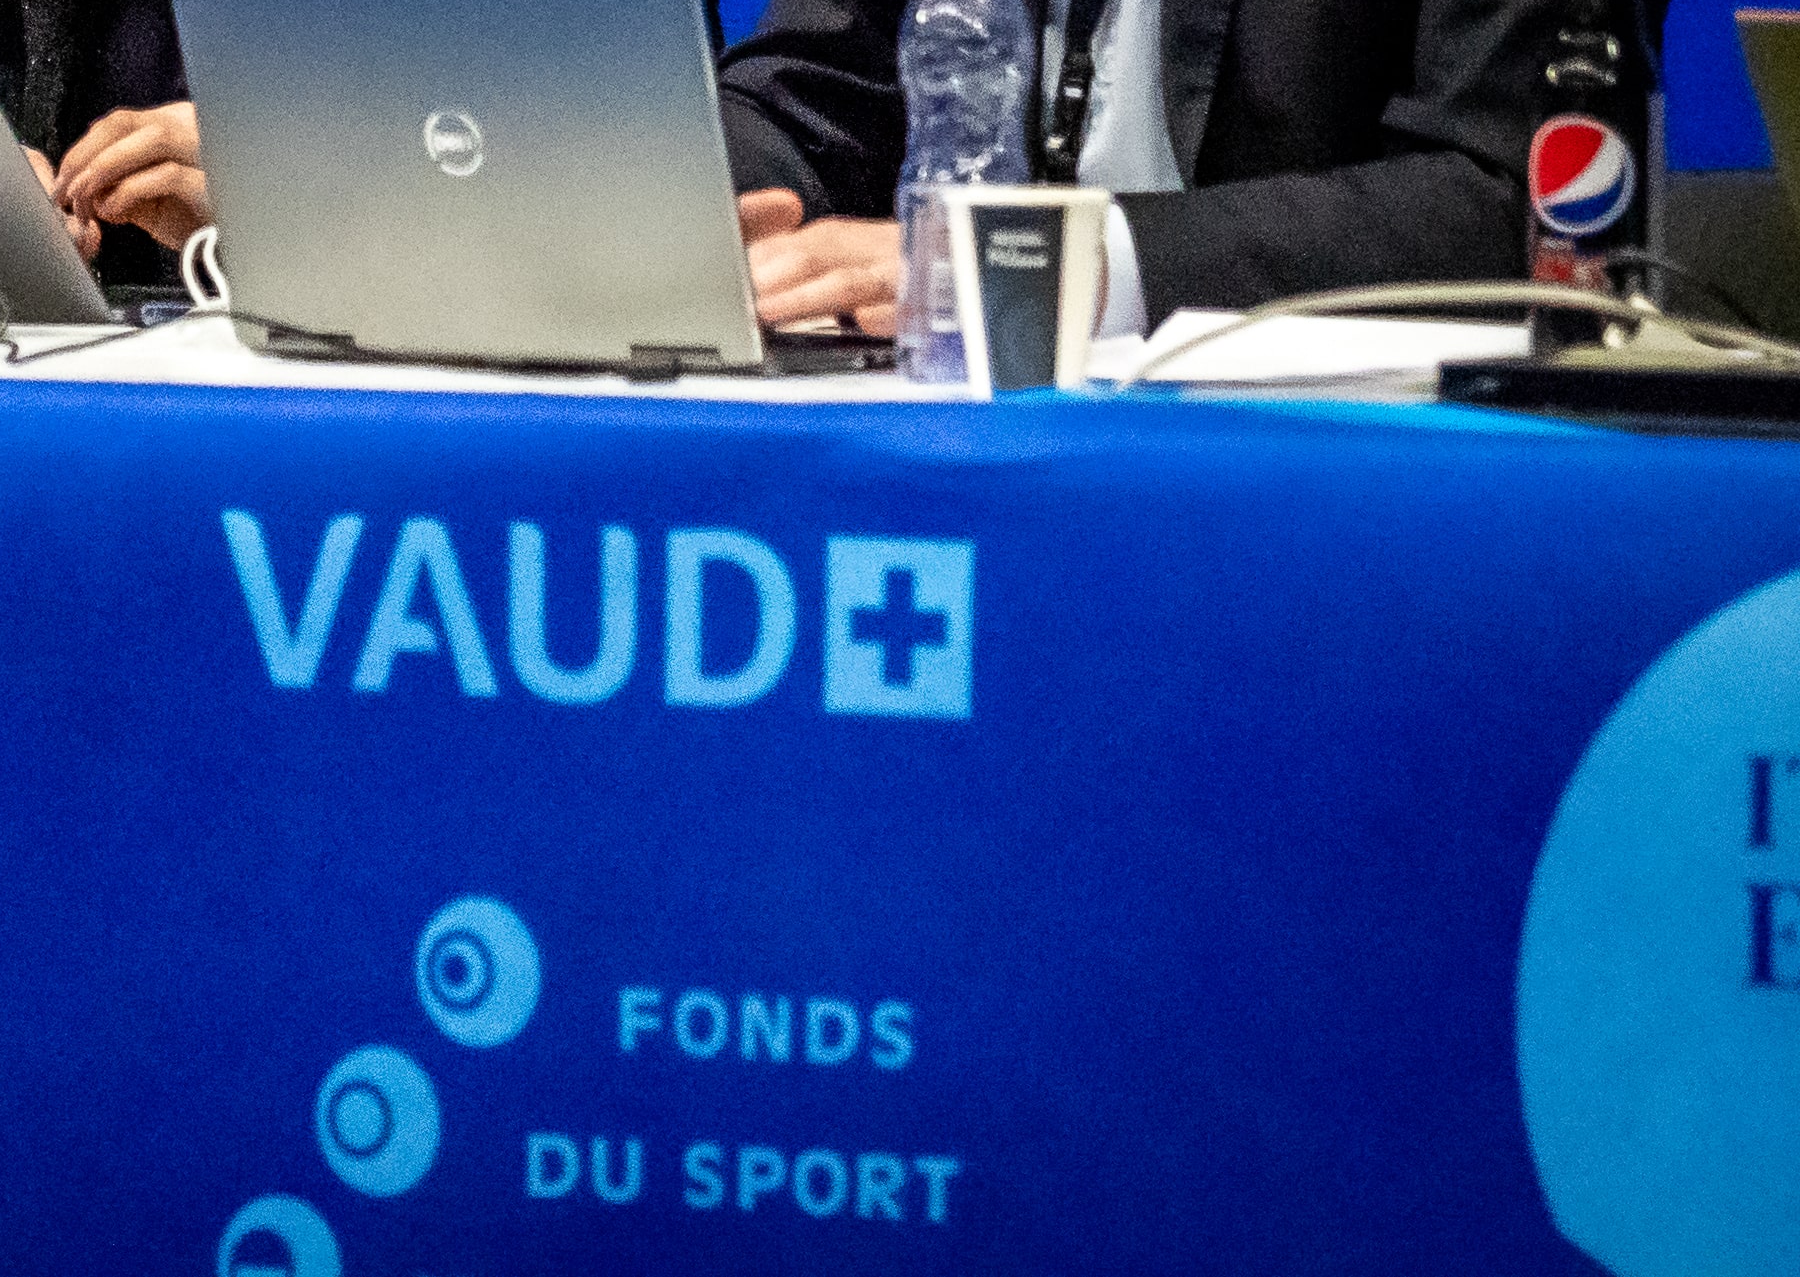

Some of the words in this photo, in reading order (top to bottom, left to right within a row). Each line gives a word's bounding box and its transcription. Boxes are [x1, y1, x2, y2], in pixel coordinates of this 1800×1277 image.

[220, 507, 799, 709] VAUD
[618, 986, 913, 1070] FONDS
[528, 1133, 642, 1202] DU
[684, 1142, 960, 1223] SPORT
